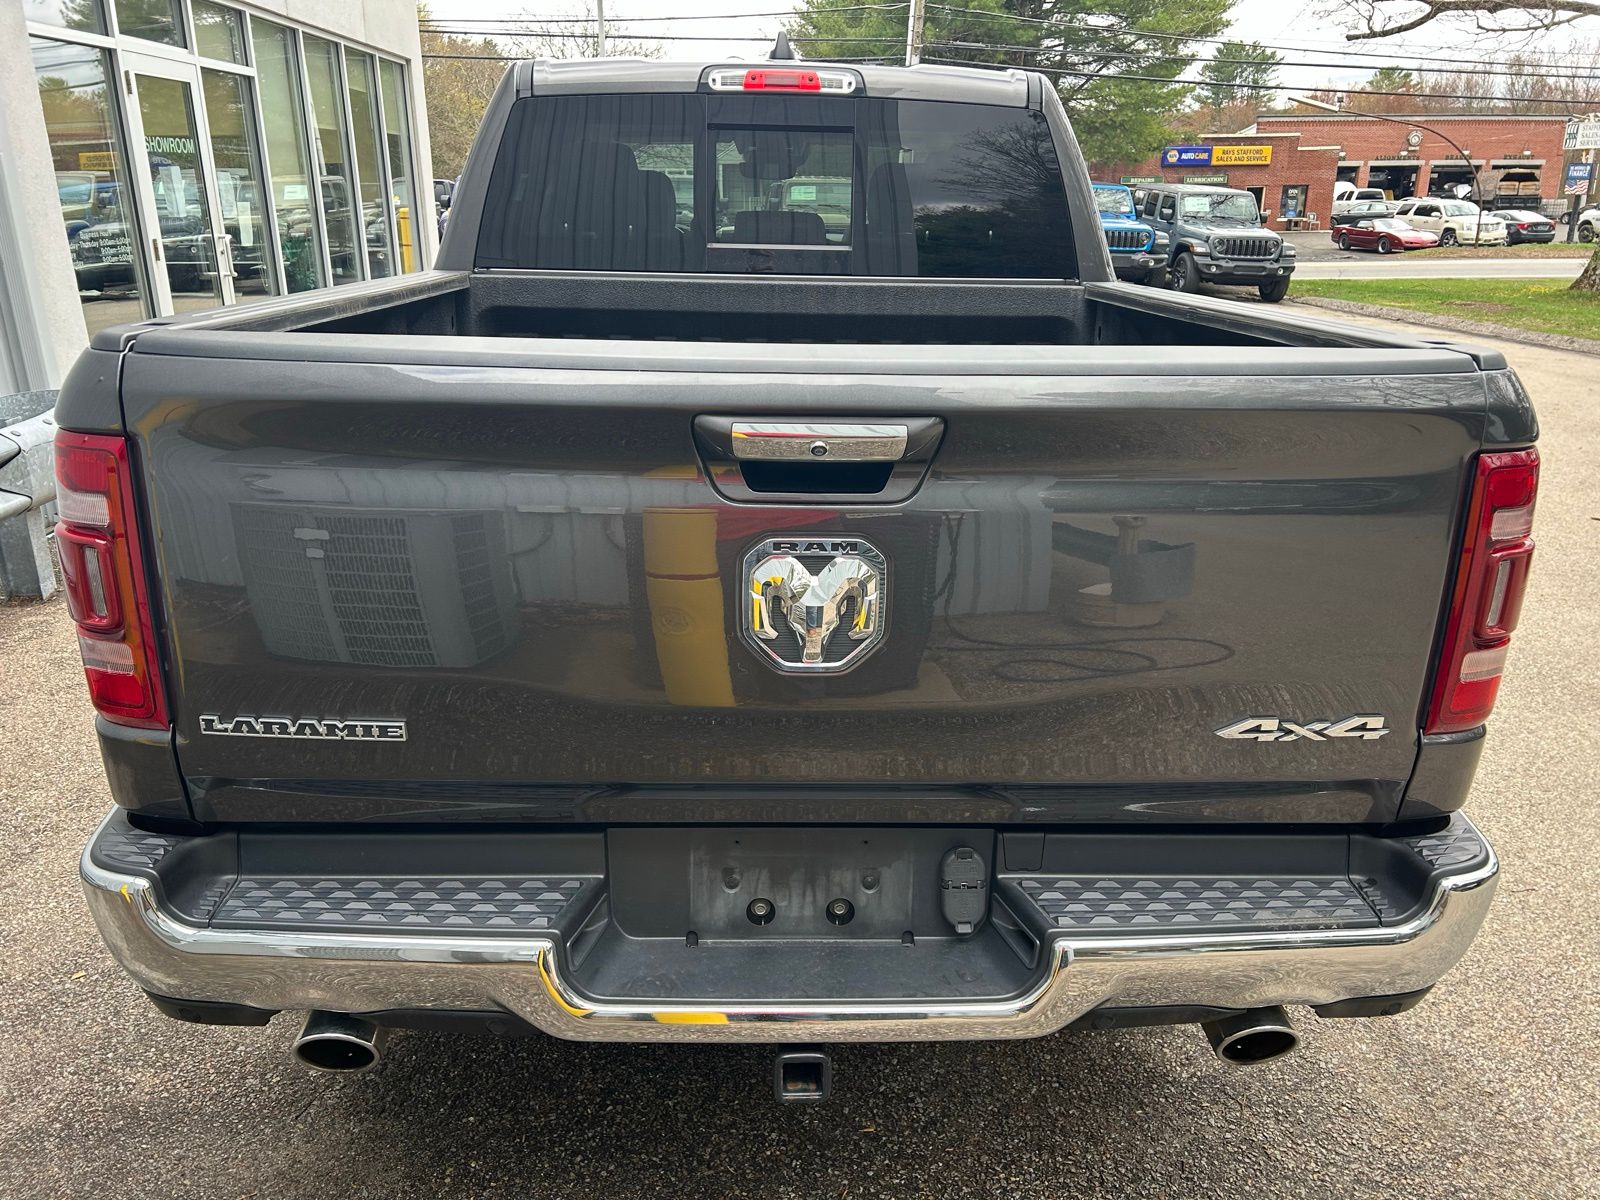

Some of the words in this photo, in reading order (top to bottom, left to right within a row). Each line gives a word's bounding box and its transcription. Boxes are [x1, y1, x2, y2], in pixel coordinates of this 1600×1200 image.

[144, 136, 195, 153] SHOWROOM
[772, 542, 859, 553] RAM
[200, 715, 407, 742] LARAMIE
